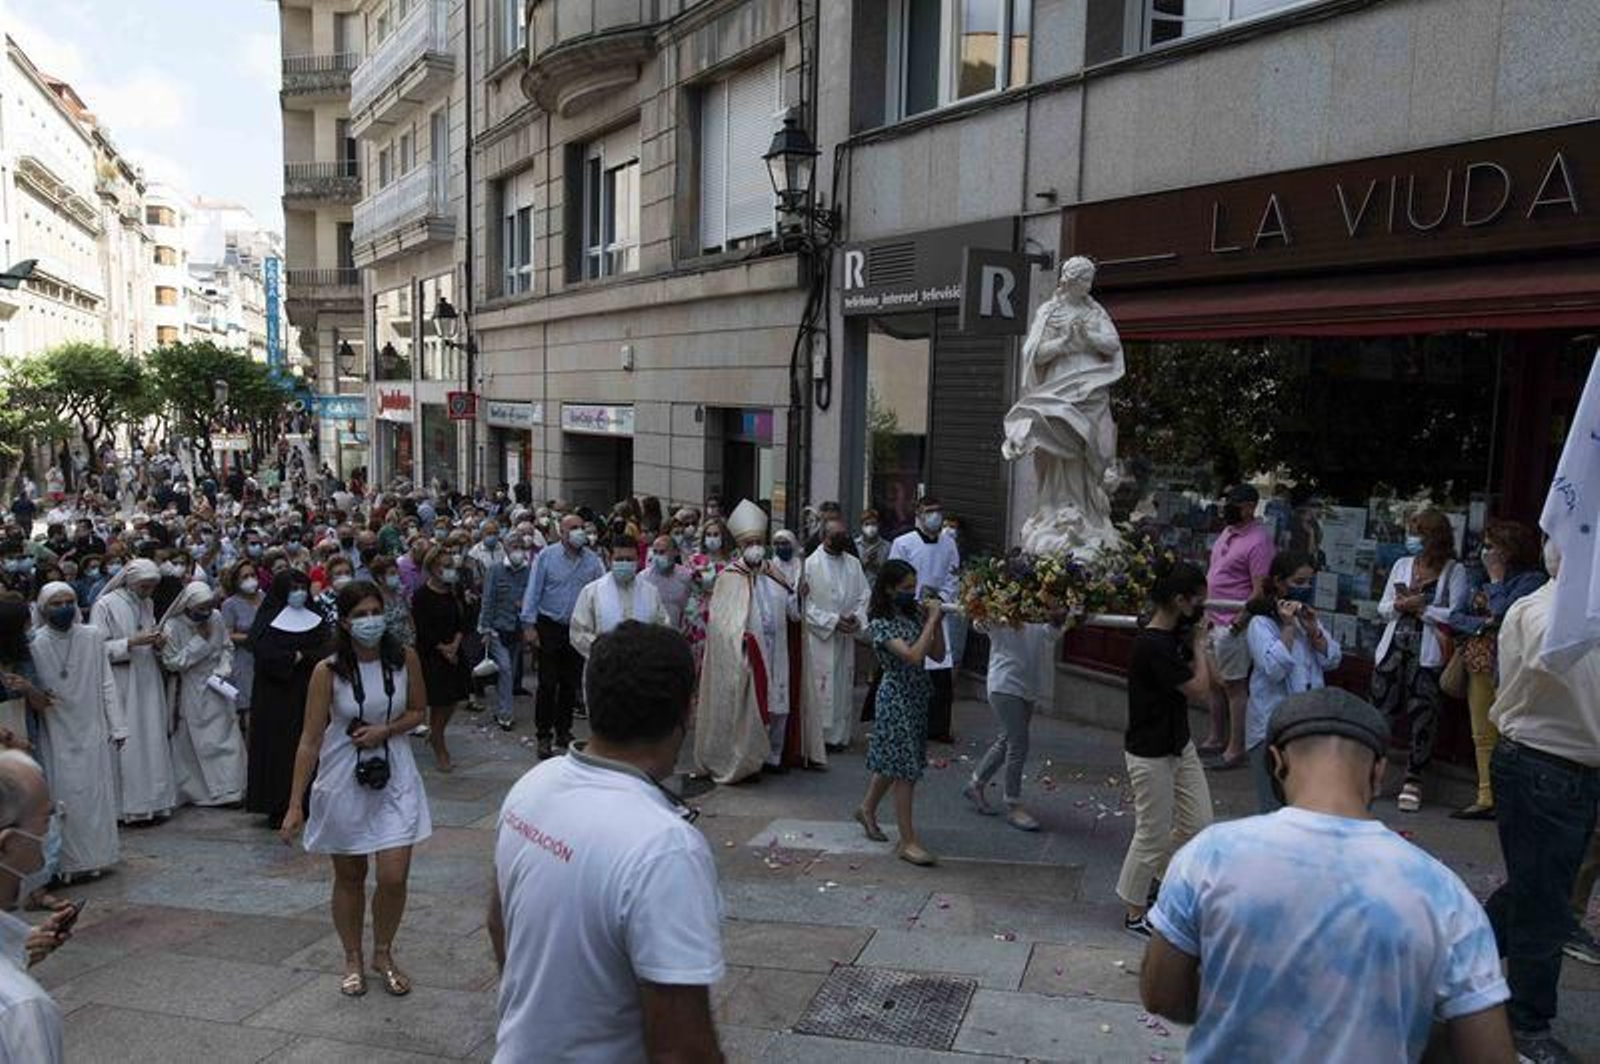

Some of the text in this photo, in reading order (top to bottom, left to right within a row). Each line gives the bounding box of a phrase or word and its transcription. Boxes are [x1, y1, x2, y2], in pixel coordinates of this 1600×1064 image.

[1210, 152, 1579, 253] LA VIUDA
[845, 250, 865, 289] R
[980, 265, 1015, 318] R
